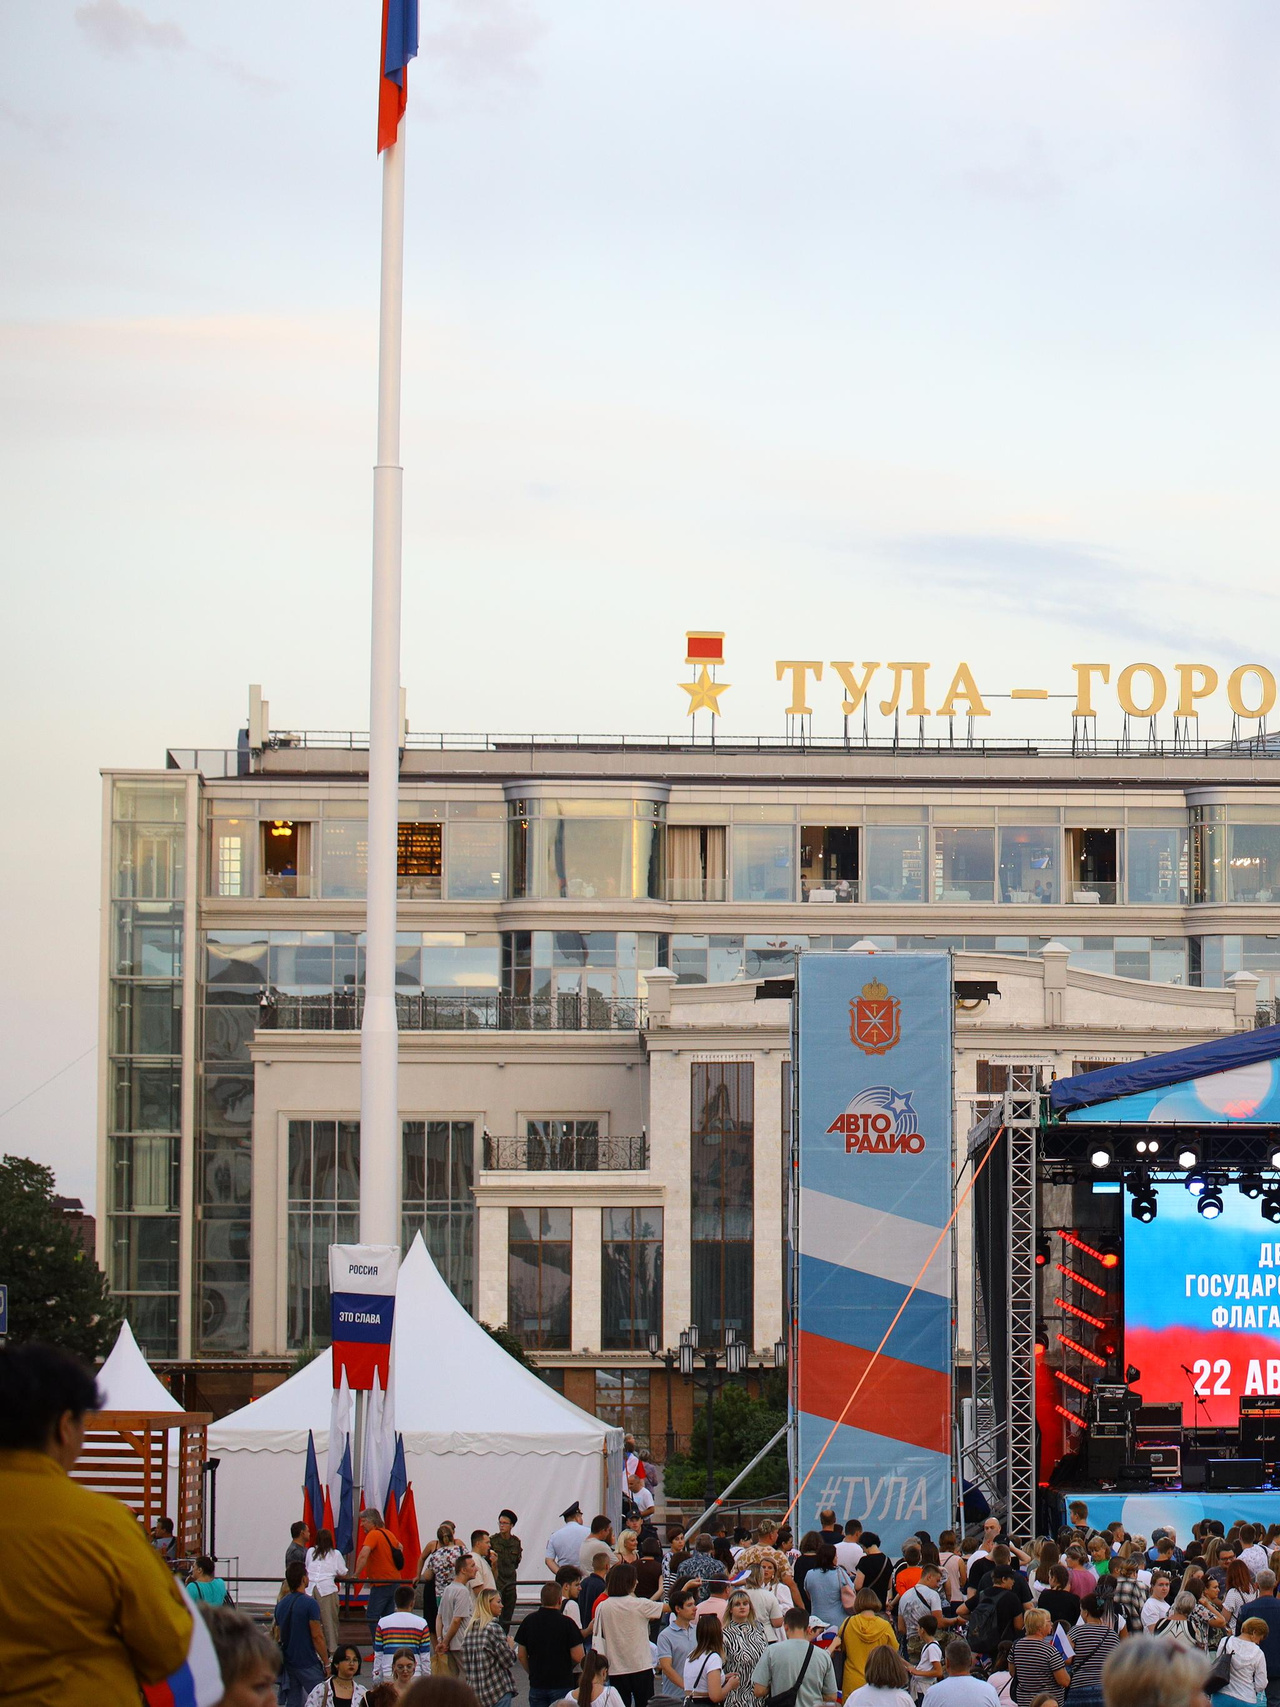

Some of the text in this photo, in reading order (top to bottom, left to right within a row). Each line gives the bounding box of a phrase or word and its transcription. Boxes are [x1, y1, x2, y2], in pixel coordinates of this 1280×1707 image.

[775, 661, 987, 717] ТУЛА
[826, 1113, 891, 1134] АВТО
[845, 1133, 926, 1154] РАДИО
[349, 1264, 378, 1275] РОССИЯ
[339, 1311, 381, 1324] ЭТО СЛАВА
[1211, 1305, 1280, 1328] ФЛАГА
[1193, 1359, 1231, 1396] 22
[814, 1476, 928, 1521] #ТУЛА
